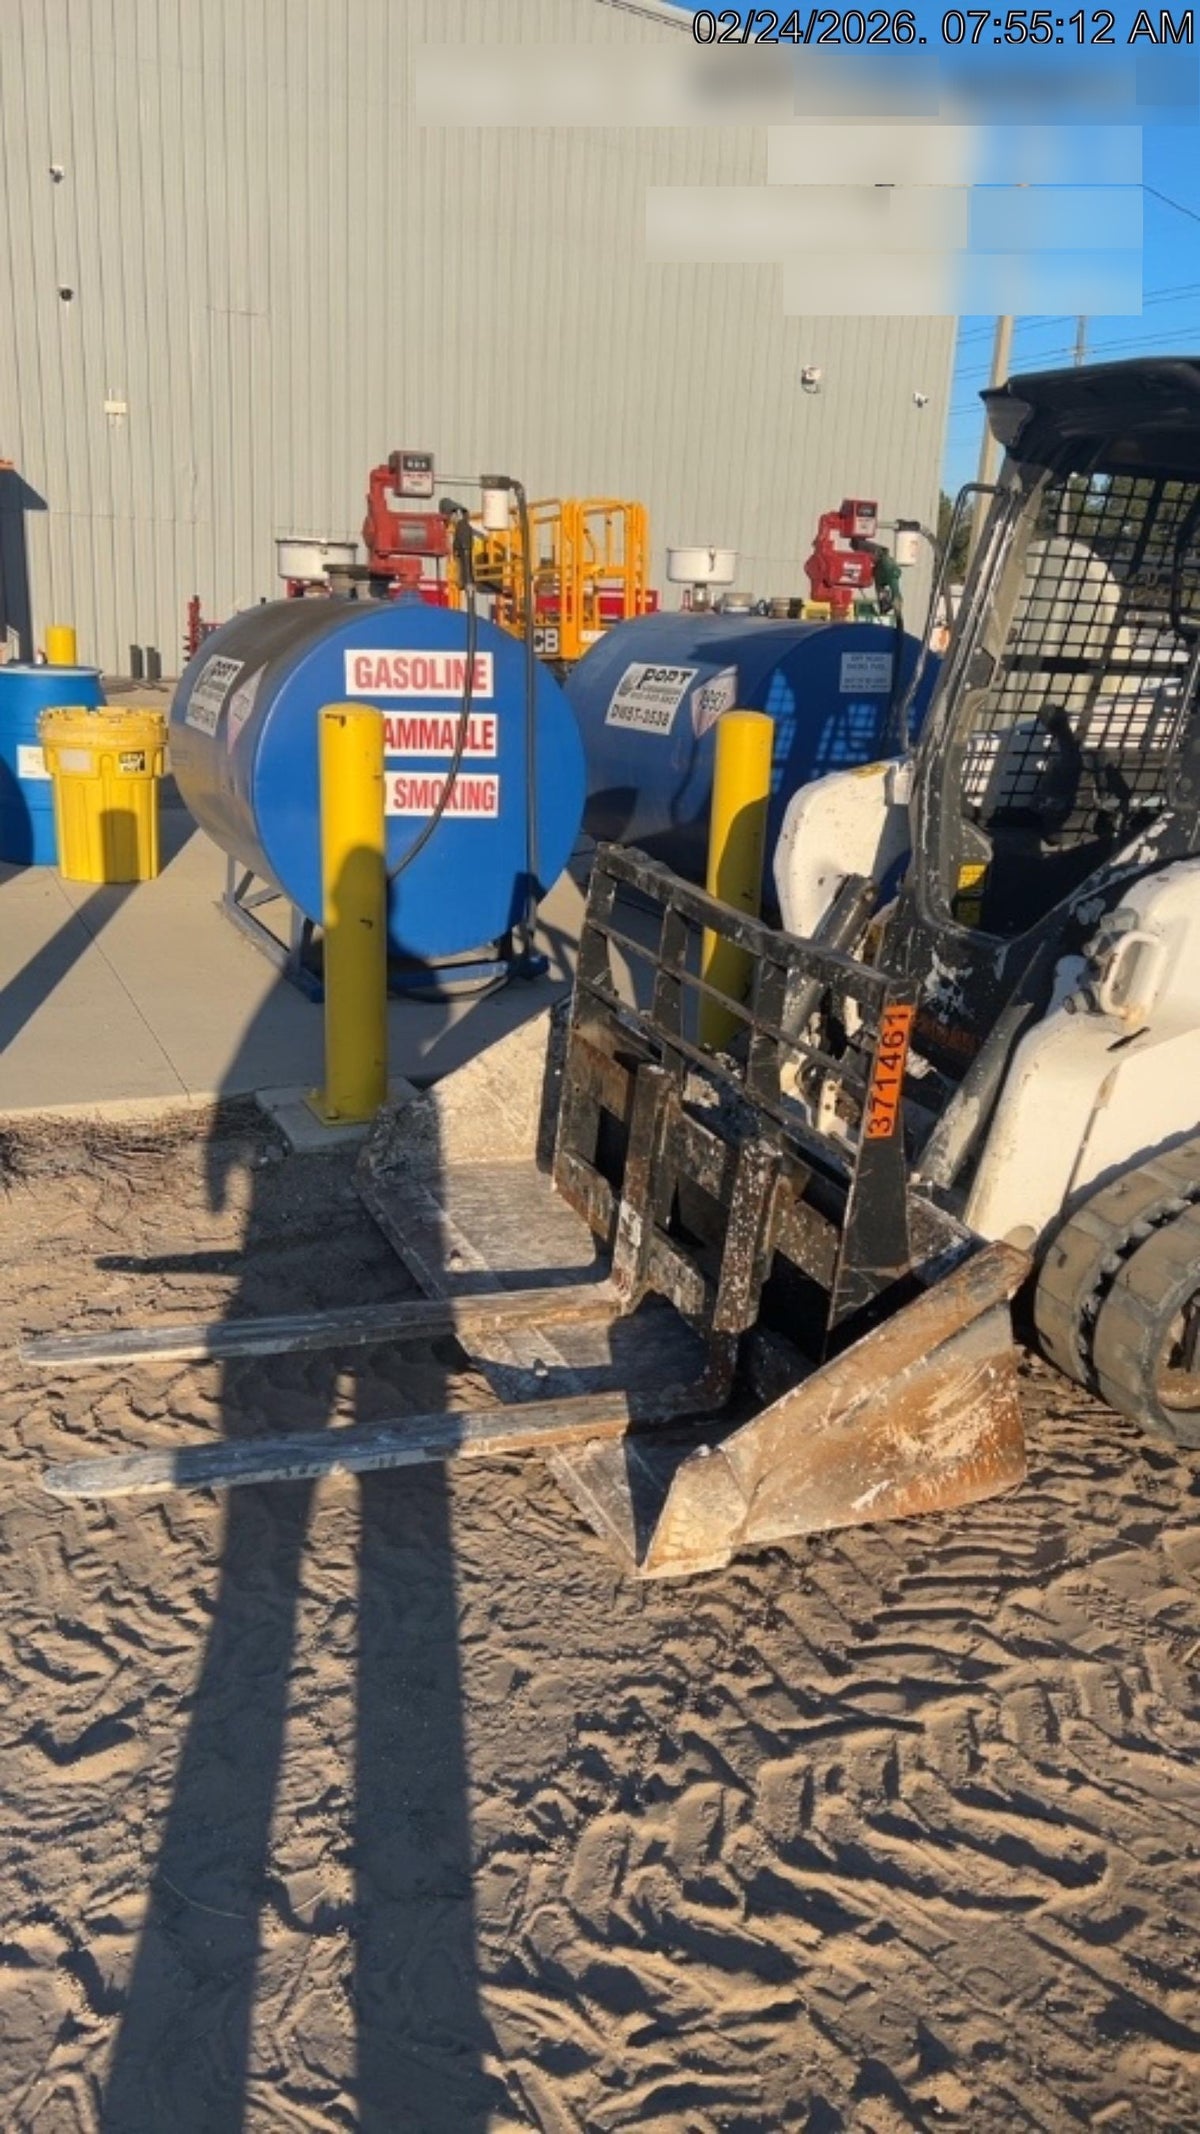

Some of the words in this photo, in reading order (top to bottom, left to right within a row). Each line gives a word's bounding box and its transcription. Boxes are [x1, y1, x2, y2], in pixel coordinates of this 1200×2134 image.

[533, 627, 559, 653] CB
[354, 656, 487, 691] GASOLINE
[384, 718, 494, 750] AMMALE
[393, 777, 496, 812] SMOKING
[868, 1013, 909, 1135] 371461
